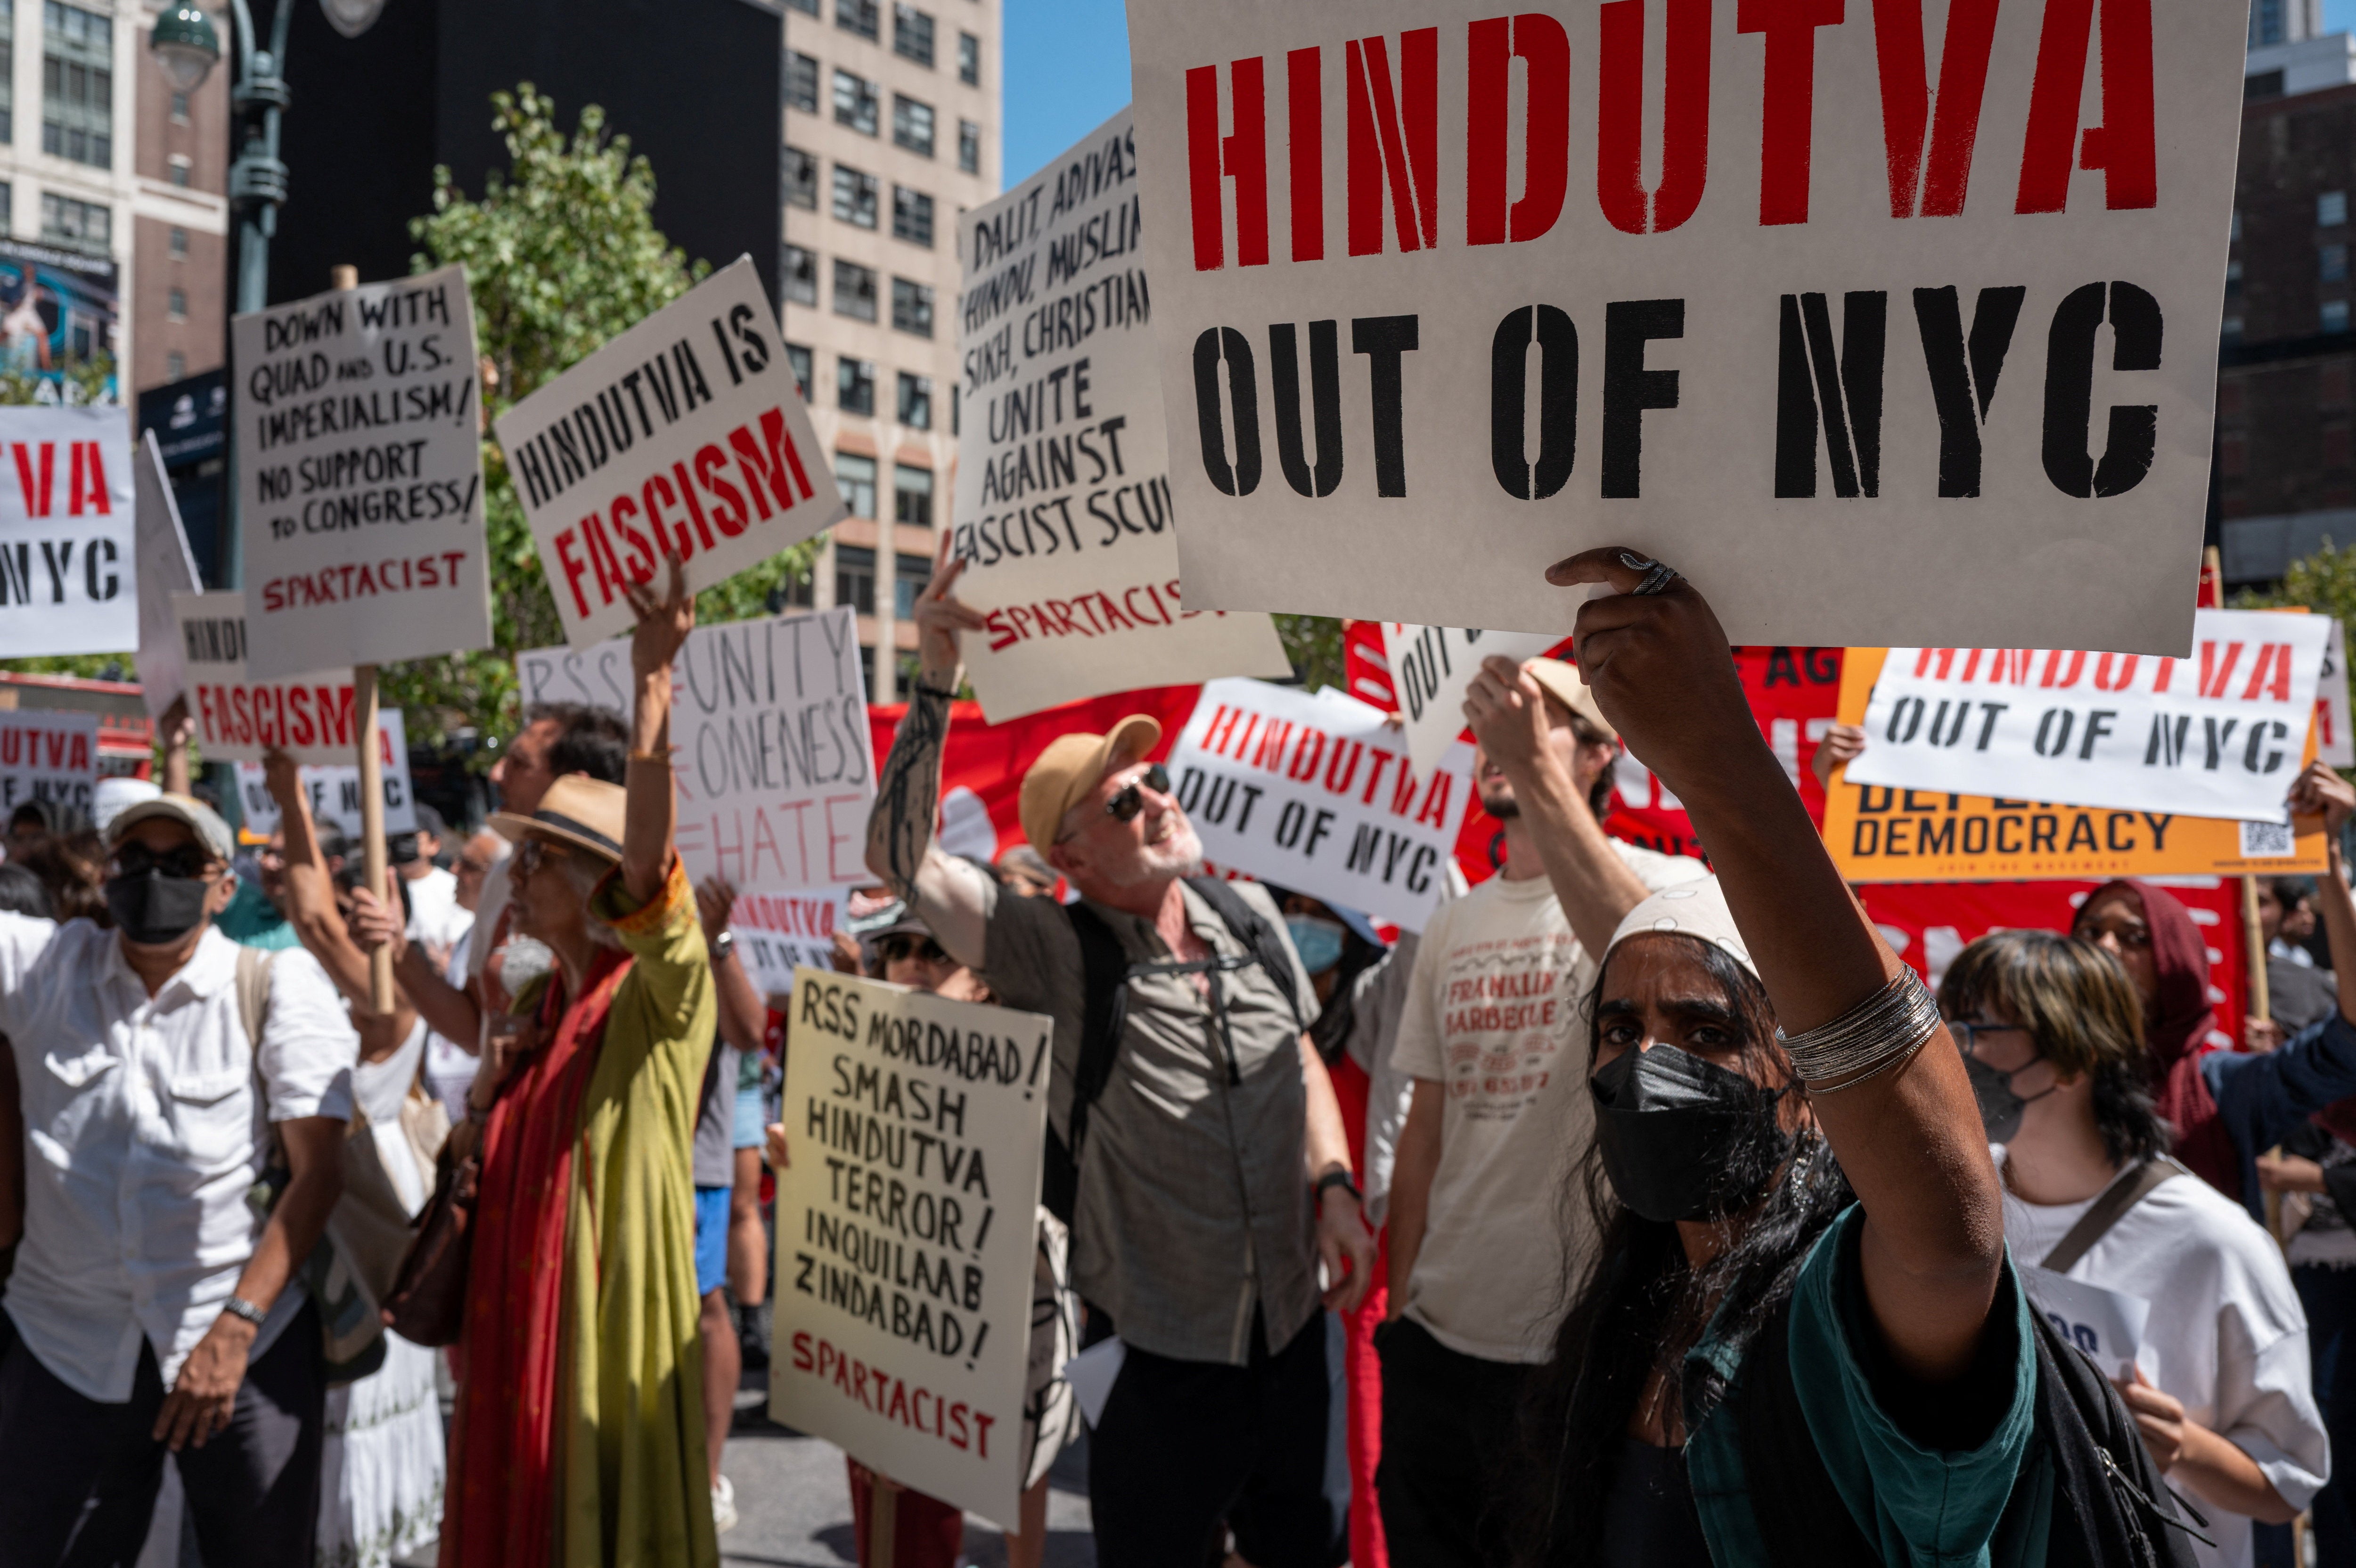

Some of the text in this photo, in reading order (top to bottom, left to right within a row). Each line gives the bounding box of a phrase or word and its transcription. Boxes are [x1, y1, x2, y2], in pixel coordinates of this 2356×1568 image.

[1186, 0, 2157, 271] HINDUTVA
[265, 284, 450, 352] DOWN WITH
[965, 252, 1036, 335] HINDU,
[250, 334, 452, 406] QUAD AND U.S.
[965, 323, 1018, 398] SIKH,
[990, 357, 1093, 444] UNITE
[1193, 281, 2163, 500] OUT OF NYC
[259, 378, 472, 452] IMPERIALISM!
[515, 302, 770, 510] HINDUTVA IS
[0, 440, 112, 519] VA
[258, 439, 428, 504] NO SUPPORT
[303, 474, 479, 534] CONGRESS!
[981, 414, 1126, 507] AGAINST
[553, 406, 815, 621] FASCISM
[954, 473, 1175, 573] FASCIST SCU
[0, 539, 118, 606] NYC
[262, 550, 466, 613] SPARTACIST
[985, 579, 1227, 653] SPARTACI
[683, 608, 851, 715] UNITY
[197, 684, 358, 747] FASCISM
[696, 694, 868, 799] ONENESS
[1886, 694, 2009, 752] OUT
[2034, 708, 2117, 761] OF
[2144, 711, 2288, 775] NYC
[1200, 704, 1453, 831] HINDUTVA
[1178, 766, 1265, 834] OUT
[1275, 799, 1337, 858] OF
[1346, 822, 1438, 895] NYC
[1853, 812, 2174, 857] DEMOCRACY
[801, 979, 1047, 1101] RSS MORDABAD!
[832, 1054, 966, 1139] SMASH
[806, 1096, 990, 1200] HINDUTVA
[826, 1156, 994, 1260] TERROR!
[806, 1208, 984, 1313] INQUILAAB
[794, 1251, 990, 1372] ZINDABAD!
[792, 1331, 996, 1461] SPARTACIST
